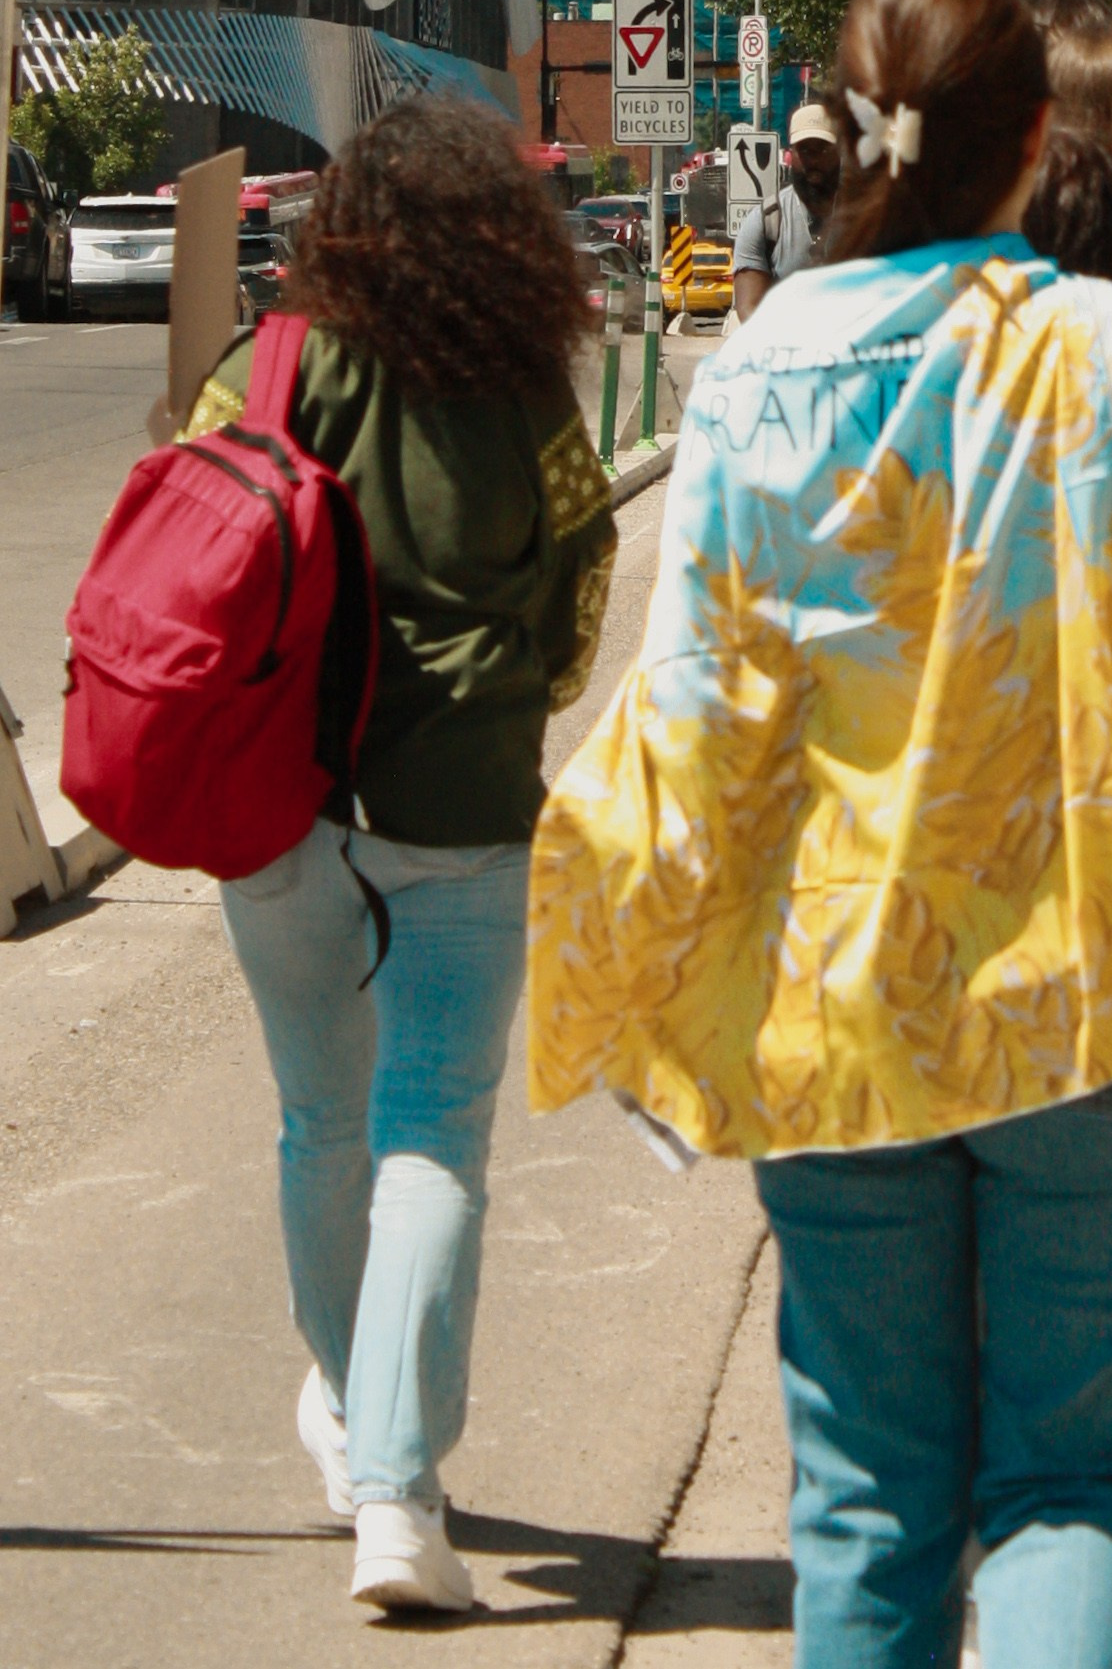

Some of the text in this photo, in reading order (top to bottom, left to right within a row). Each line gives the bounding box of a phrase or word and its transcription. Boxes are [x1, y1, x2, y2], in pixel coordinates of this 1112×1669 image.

[621, 100, 685, 114] YIELD TO
[620, 120, 685, 133] BICYCLES
